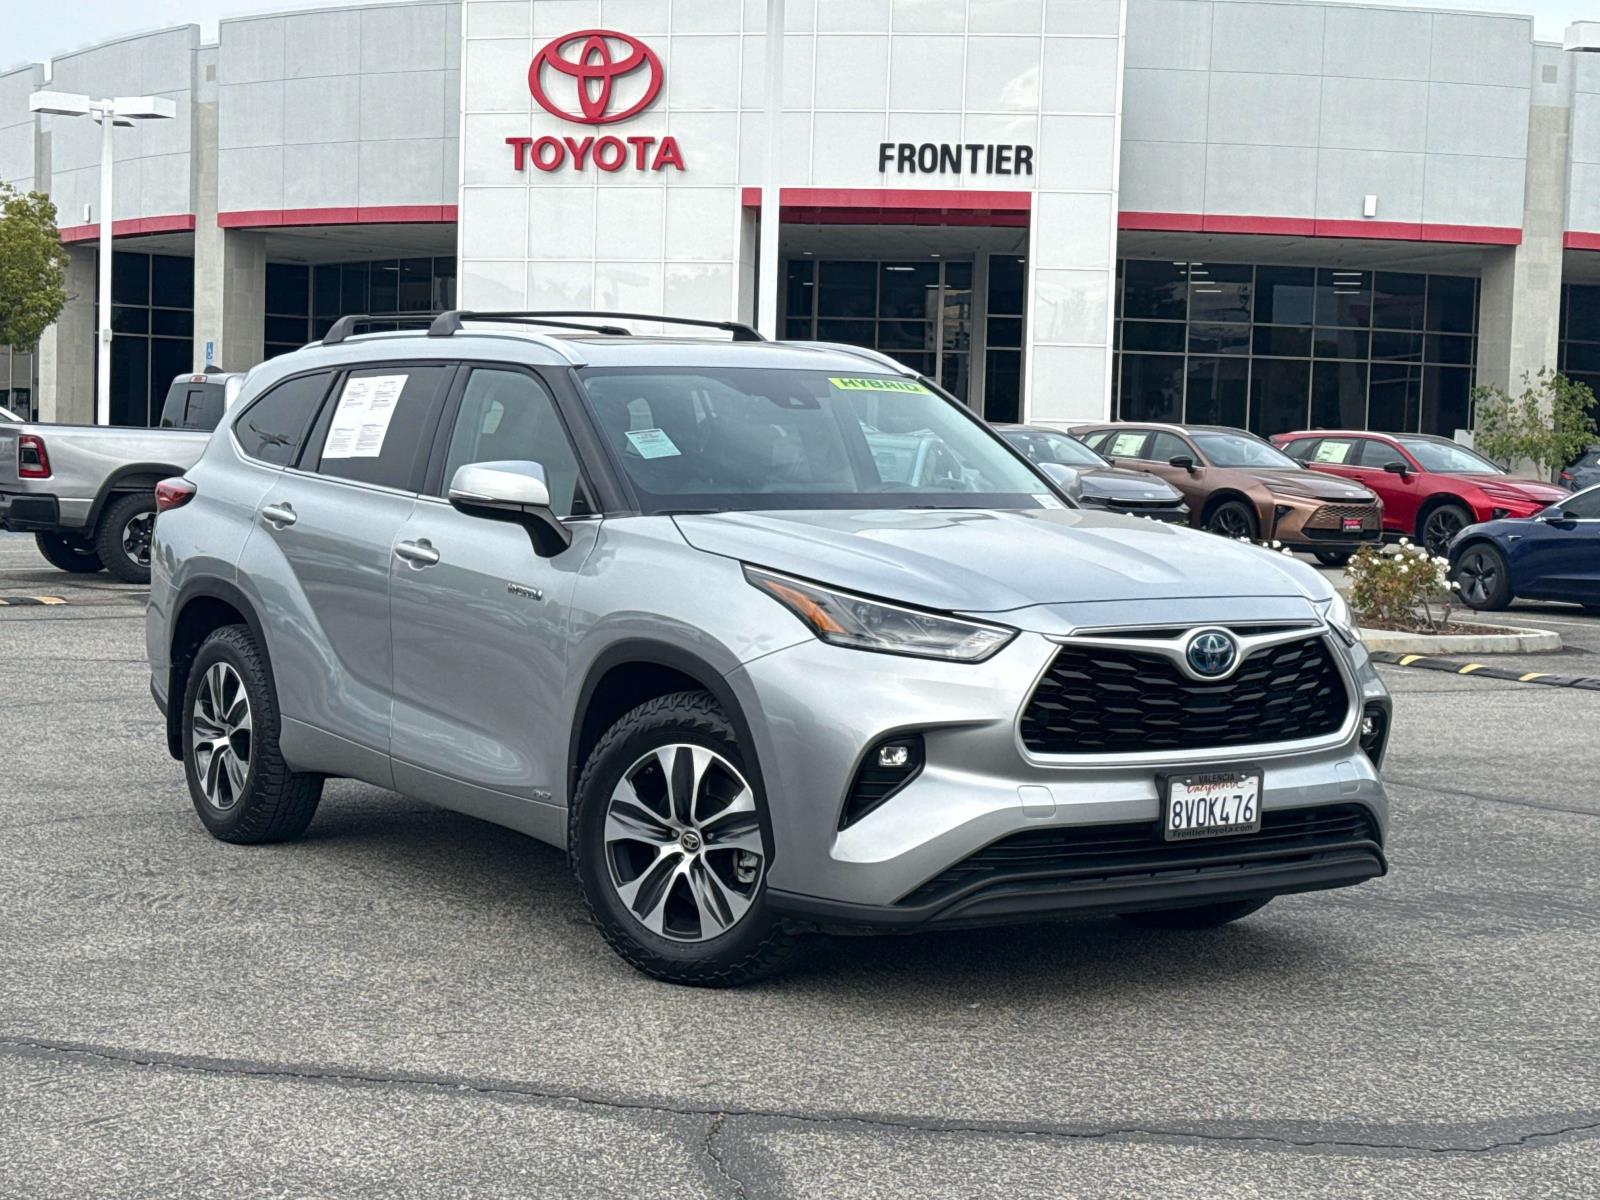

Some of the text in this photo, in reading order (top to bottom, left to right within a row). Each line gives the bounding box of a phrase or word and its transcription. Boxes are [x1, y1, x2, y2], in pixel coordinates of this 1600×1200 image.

[505, 137, 685, 171] TOYOTA
[878, 142, 1033, 175] FRONTIER
[839, 378, 922, 393] HYBRID
[1199, 773, 1235, 784] VALENCIA
[1172, 793, 1255, 829] 8VOK476
